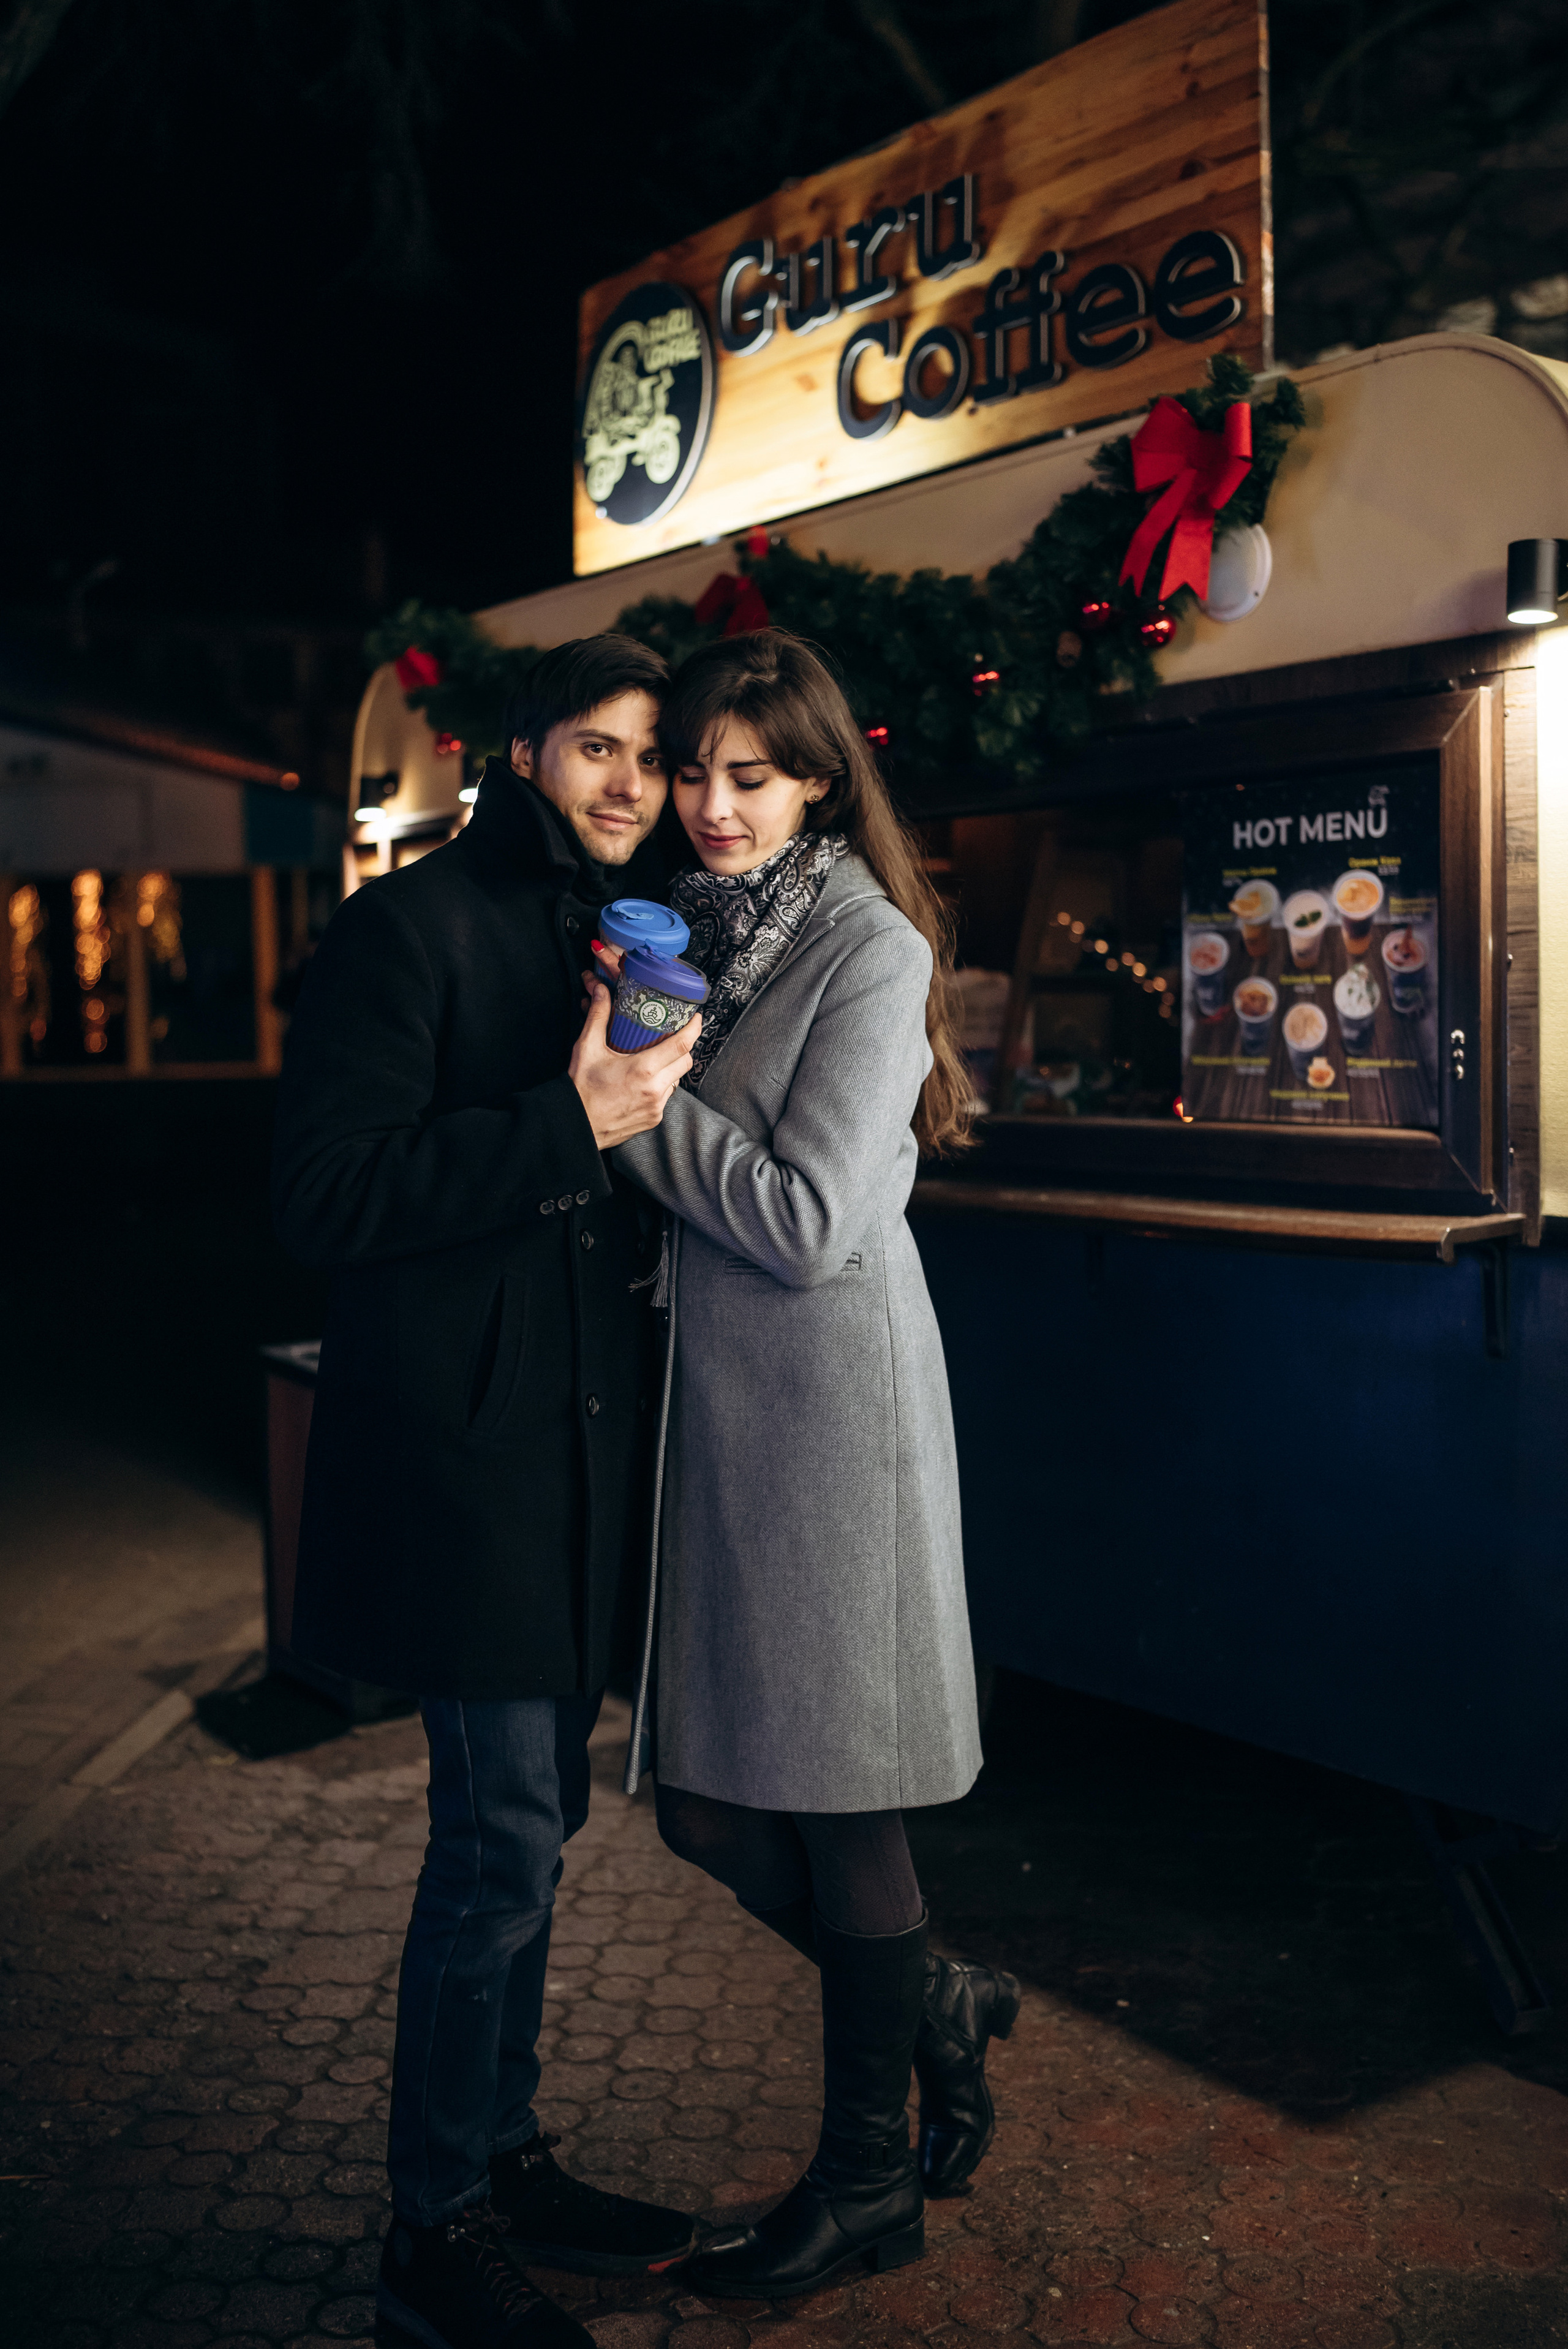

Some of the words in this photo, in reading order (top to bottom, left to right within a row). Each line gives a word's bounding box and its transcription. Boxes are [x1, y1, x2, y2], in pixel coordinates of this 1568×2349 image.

[719, 173, 981, 357] Guru
[836, 230, 1246, 442] Coffee
[1232, 816, 1294, 850] HOT
[1299, 806, 1389, 844] MENU
